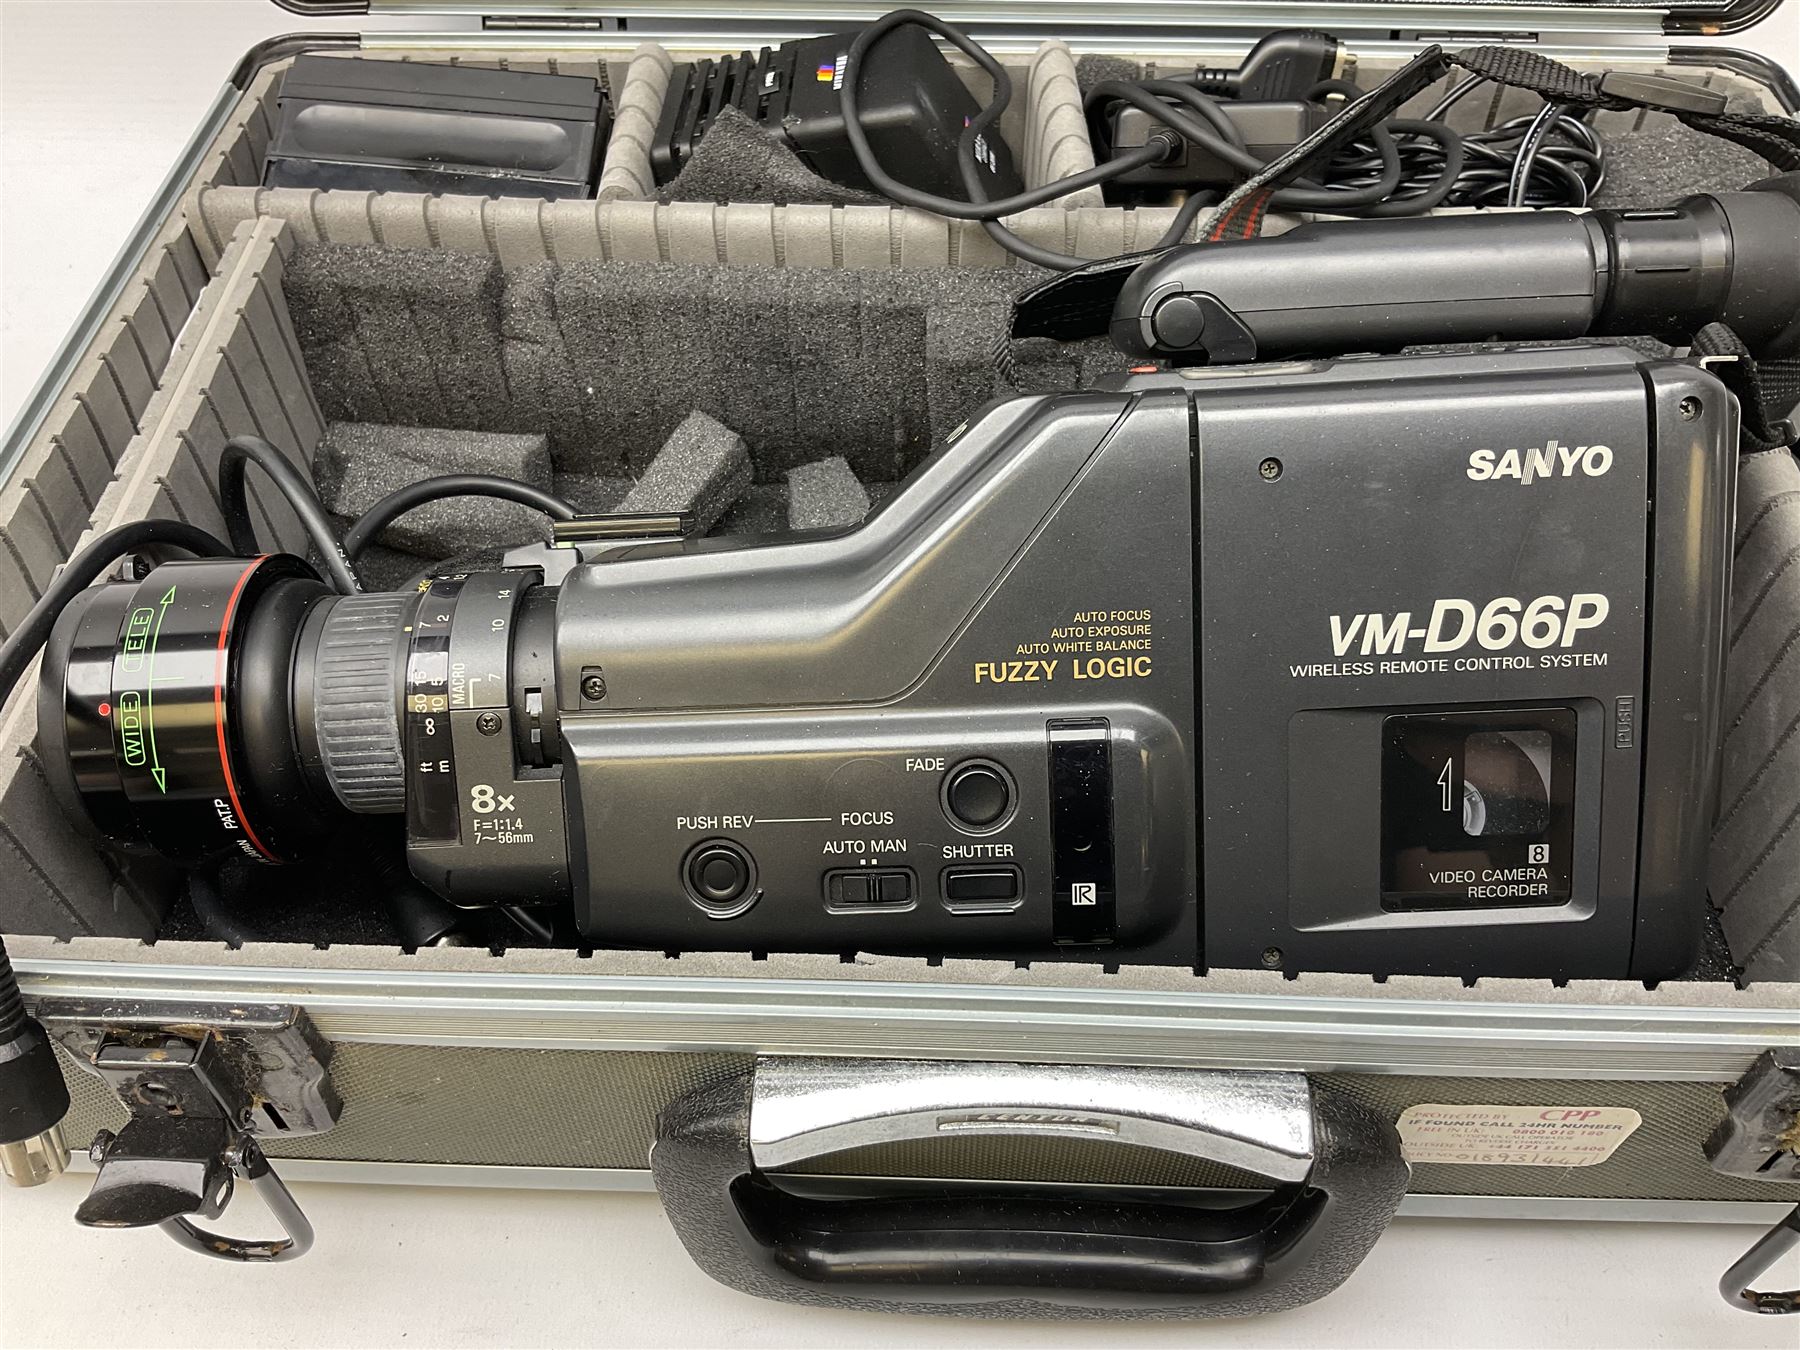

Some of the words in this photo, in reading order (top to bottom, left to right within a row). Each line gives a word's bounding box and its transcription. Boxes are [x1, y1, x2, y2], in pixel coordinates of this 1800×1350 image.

[1467, 440, 1613, 485] SANYO
[497, 588, 512, 600] 14
[437, 613, 450, 622] 2
[491, 617, 505, 632] 10
[1074, 611, 1106, 623] AUTO
[1109, 610, 1151, 622] FOCUS
[418, 621, 432, 629] 7
[1051, 626, 1083, 638] AUTO
[1087, 624, 1152, 637] EXPOSURE
[1329, 593, 1609, 657] VM-D66P
[127, 613, 151, 664] TELE
[1016, 642, 1049, 654] AUTO
[1052, 641, 1091, 653] WHITE
[1095, 639, 1152, 652] BALANCE
[974, 660, 1059, 684] FUZZY
[1073, 657, 1152, 680] LOGIC
[1290, 662, 1374, 678] WIRELESS
[1380, 659, 1449, 675] REMOTE
[1454, 655, 1535, 672] CONTROL
[1540, 652, 1608, 669] SYSTEM
[415, 671, 427, 687] 15
[432, 678, 444, 687] 5
[452, 662, 466, 705] MACRO
[488, 672, 501, 682] 7
[415, 694, 427, 713] 30
[431, 697, 444, 713] 10
[126, 699, 143, 758] WIDE
[1617, 702, 1631, 742] PUSH
[420, 760, 433, 773] ft
[437, 759, 450, 773] m
[905, 758, 945, 772] FADE
[214, 798, 238, 829] PAT.P
[841, 811, 894, 826] FOCUS
[676, 815, 718, 830] PUSH
[722, 814, 754, 829] REV
[236, 839, 262, 858] JAPAN
[822, 839, 866, 854] AUTO
[870, 838, 908, 853] MAN
[942, 843, 1015, 859] SHUTTER
[1429, 868, 1476, 884] VIDEO
[1481, 866, 1549, 881] CAMERA
[1467, 883, 1549, 898] RECORDER
[1414, 1111, 1489, 1120] PROTECTED
[1540, 1109, 1601, 1121] CPP
[1560, 1123, 1624, 1131] NUMBER
